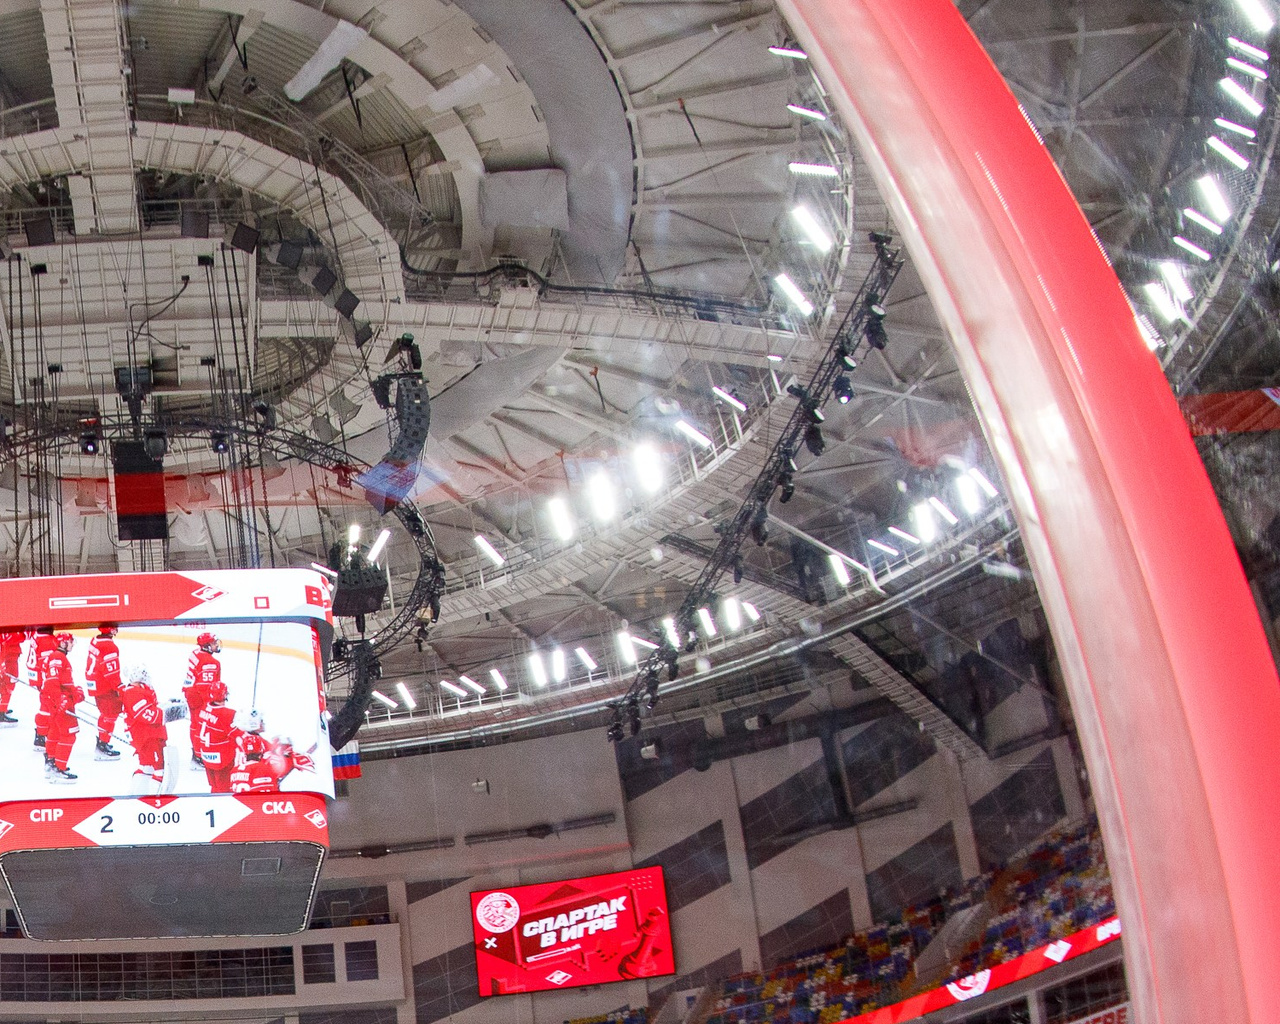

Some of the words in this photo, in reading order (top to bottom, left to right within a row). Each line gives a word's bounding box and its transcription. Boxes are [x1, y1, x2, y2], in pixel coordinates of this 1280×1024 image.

[202, 672, 214, 682] 55
[154, 799, 162, 808] 3
[261, 801, 296, 815] СКА
[29, 808, 64, 822] СПР
[137, 811, 181, 825] 00:00
[204, 809, 216, 828] 1
[99, 815, 115, 834] 2
[523, 896, 627, 937] СПАРТАК
[540, 932, 557, 948] В
[560, 914, 619, 943] ИГРЕ
